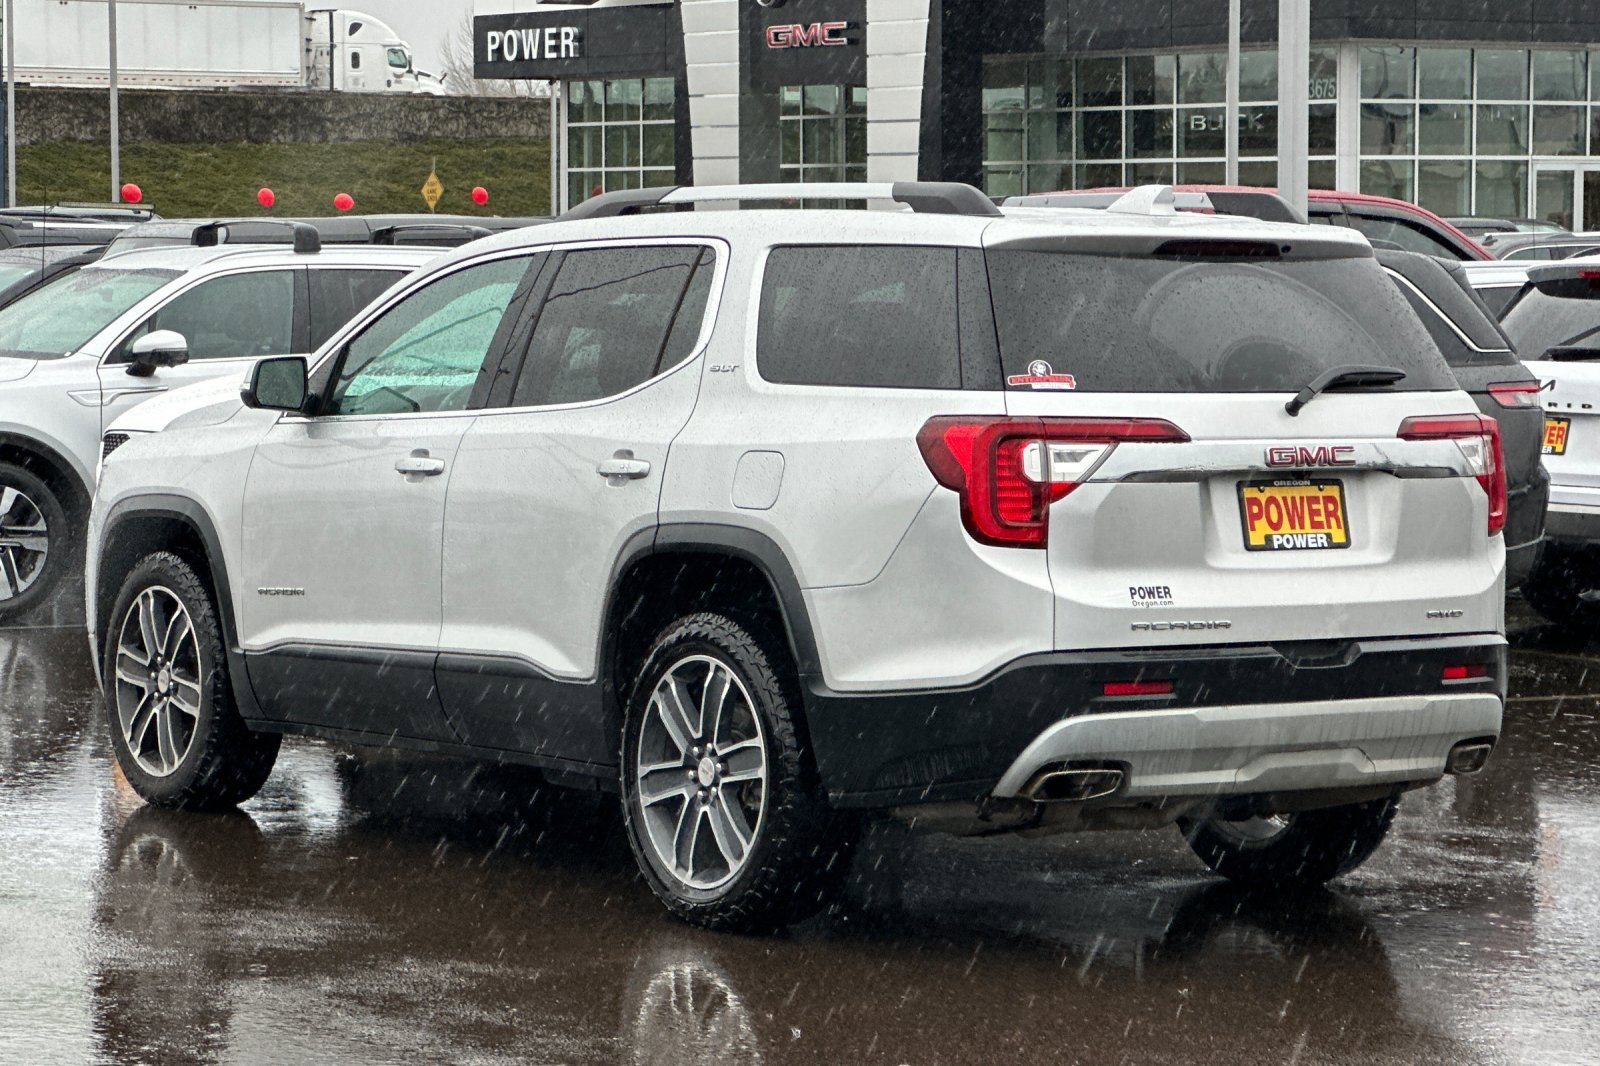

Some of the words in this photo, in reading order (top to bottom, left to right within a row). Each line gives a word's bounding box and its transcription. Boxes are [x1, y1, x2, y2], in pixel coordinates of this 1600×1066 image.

[766, 21, 848, 48] GMC
[487, 26, 579, 62] POWER
[1309, 78, 1335, 98] 3675
[1190, 113, 1264, 131] BUCK
[710, 364, 740, 373] SLT
[1265, 445, 1356, 468] GMC
[1245, 495, 1343, 532] POWER
[1272, 534, 1329, 549] POWER
[1129, 585, 1173, 600] POWER
[1132, 599, 1175, 608] Oregon.com
[1131, 620, 1232, 631] ACADIA
